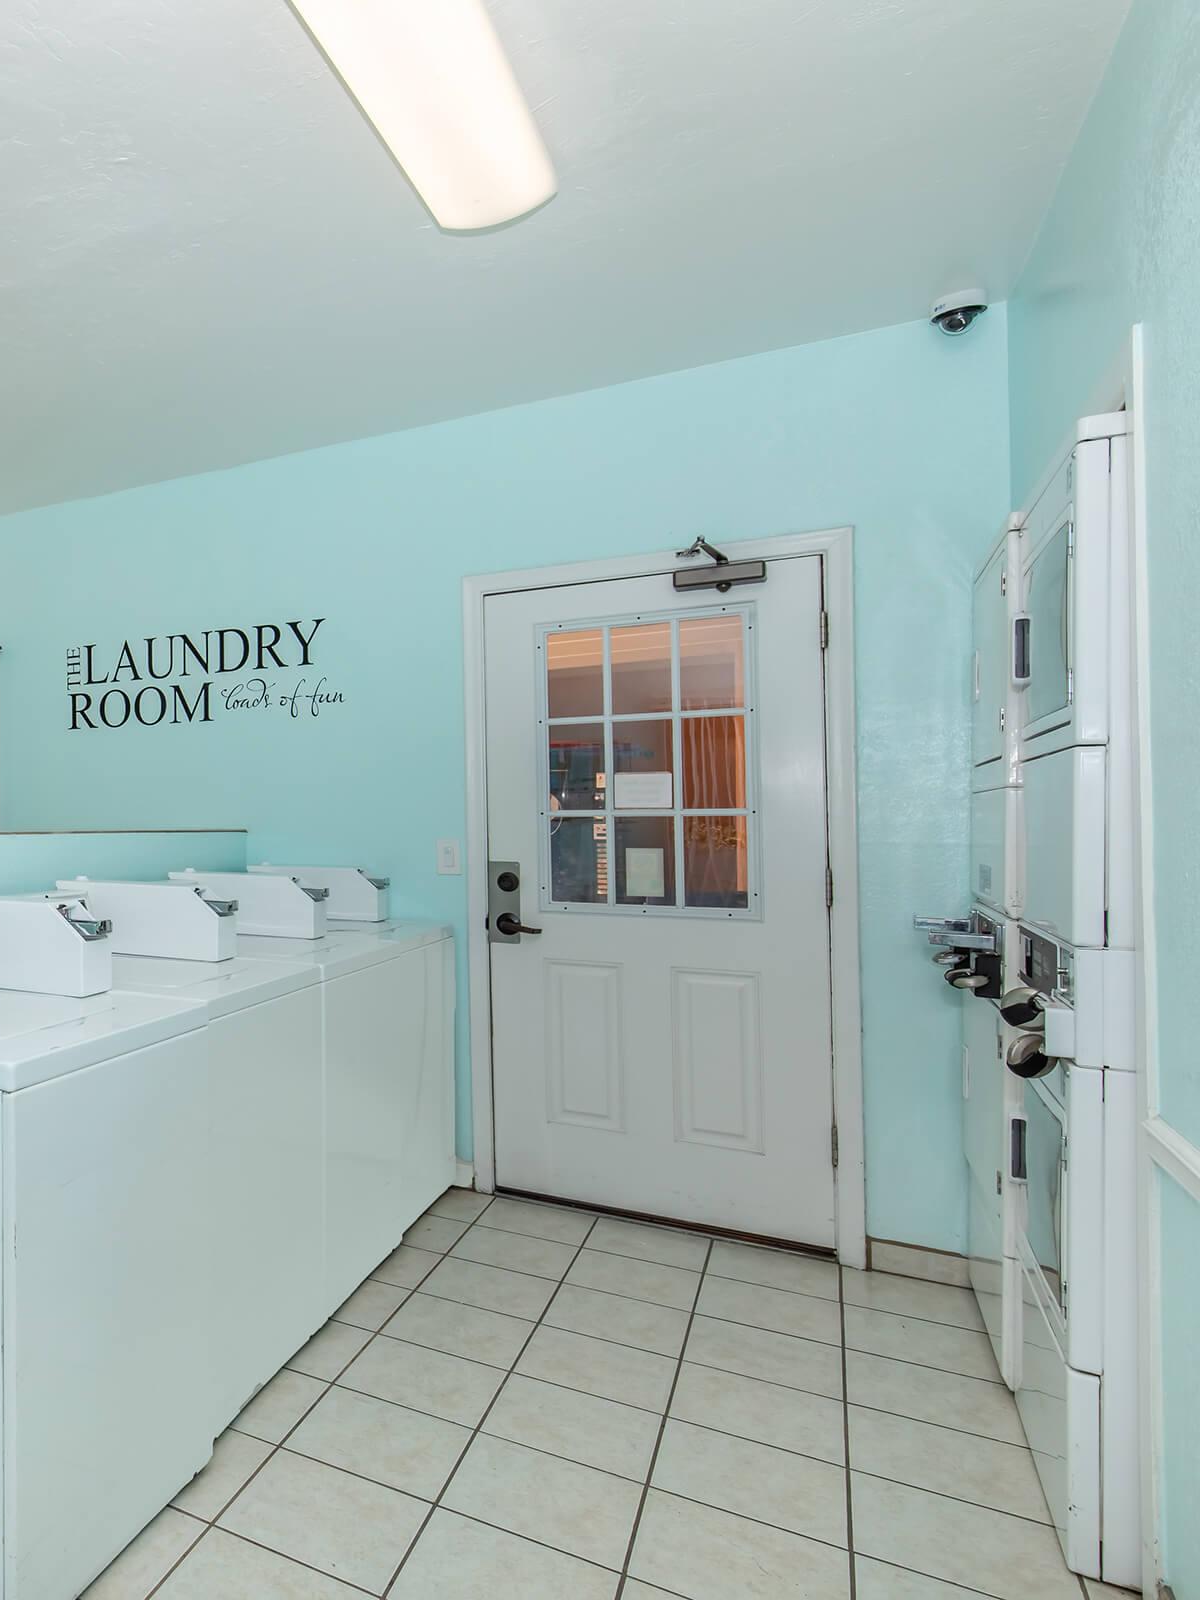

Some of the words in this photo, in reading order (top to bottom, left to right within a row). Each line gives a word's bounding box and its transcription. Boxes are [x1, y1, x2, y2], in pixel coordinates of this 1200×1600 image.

[66, 646, 81, 691] THE
[83, 617, 326, 686] LAUNDRY
[67, 681, 215, 731] ROOM
[220, 677, 276, 711] loads
[279, 677, 307, 719] of
[306, 676, 347, 718] fun
